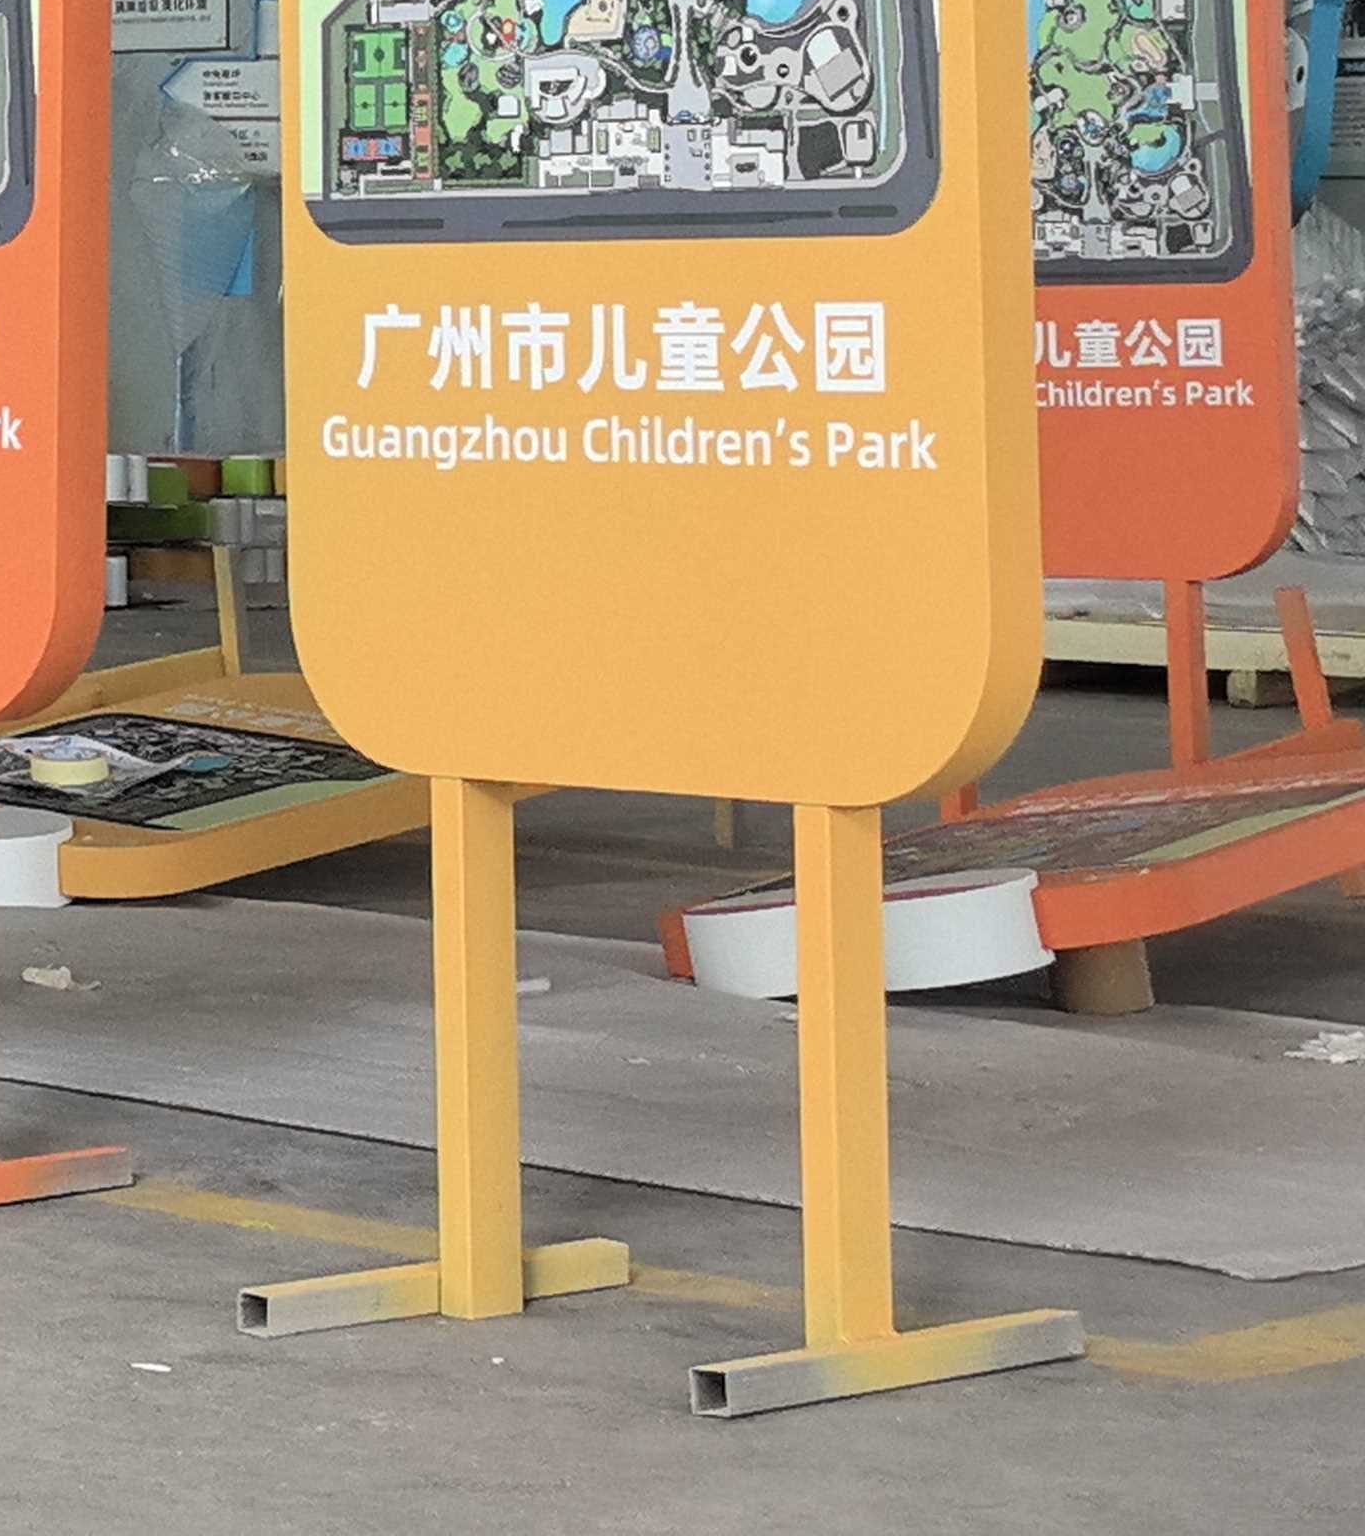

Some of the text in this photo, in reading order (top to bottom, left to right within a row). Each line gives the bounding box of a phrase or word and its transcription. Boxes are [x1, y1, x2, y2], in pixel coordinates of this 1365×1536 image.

[358, 301, 885, 392] 广州市儿童公园
[1035, 319, 1222, 367] 儿童公园
[1186, 379, 1253, 405] Park
[323, 415, 936, 470] Guangzhou Children's Park
